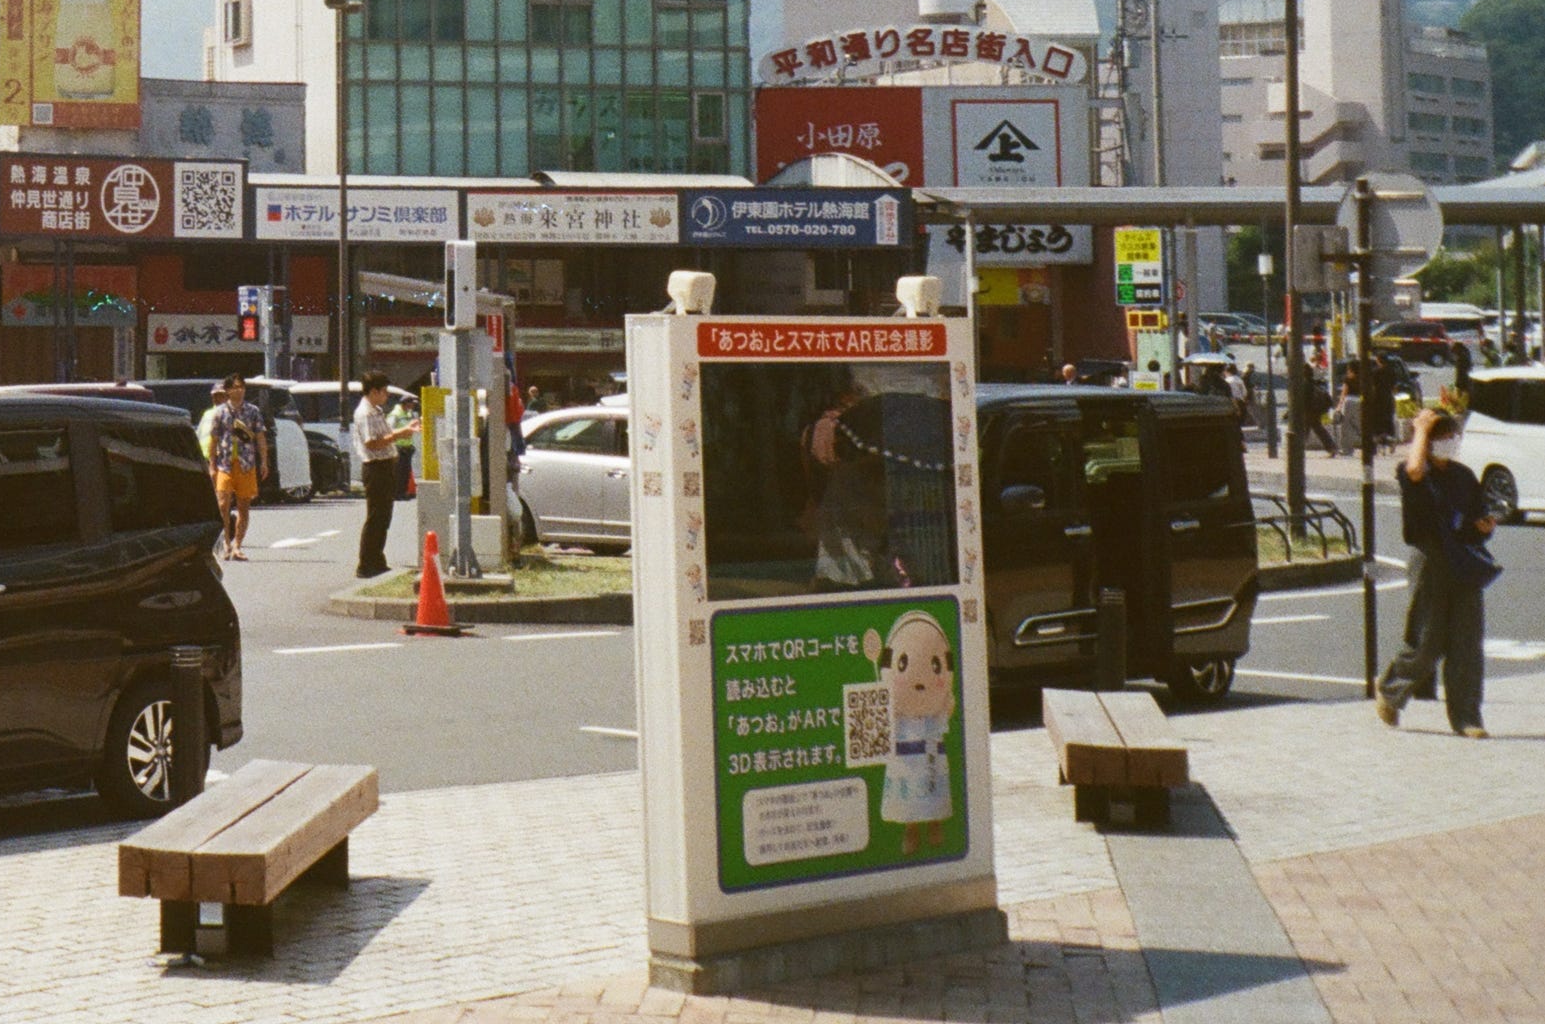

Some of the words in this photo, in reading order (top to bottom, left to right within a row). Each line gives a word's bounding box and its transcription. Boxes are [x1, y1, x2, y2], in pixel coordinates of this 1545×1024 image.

[771, 27, 1075, 79] 平和通り名店街入口
[797, 121, 883, 151] 小田原
[10, 163, 91, 186] 熱海温泉
[10, 189, 90, 210] 仲見世通り
[731, 201, 870, 220] 伊東園ホテル熱海館
[42, 211, 91, 231] 商店街
[710, 327, 935, 354] 「あつお」とスマホでAR記念撮影
[725, 635, 860, 664] スマホでQRコードを
[725, 674, 798, 702] 読み込むと
[728, 707, 843, 737] 「あつお」がARで
[728, 744, 842, 775] 3D表示されます。
